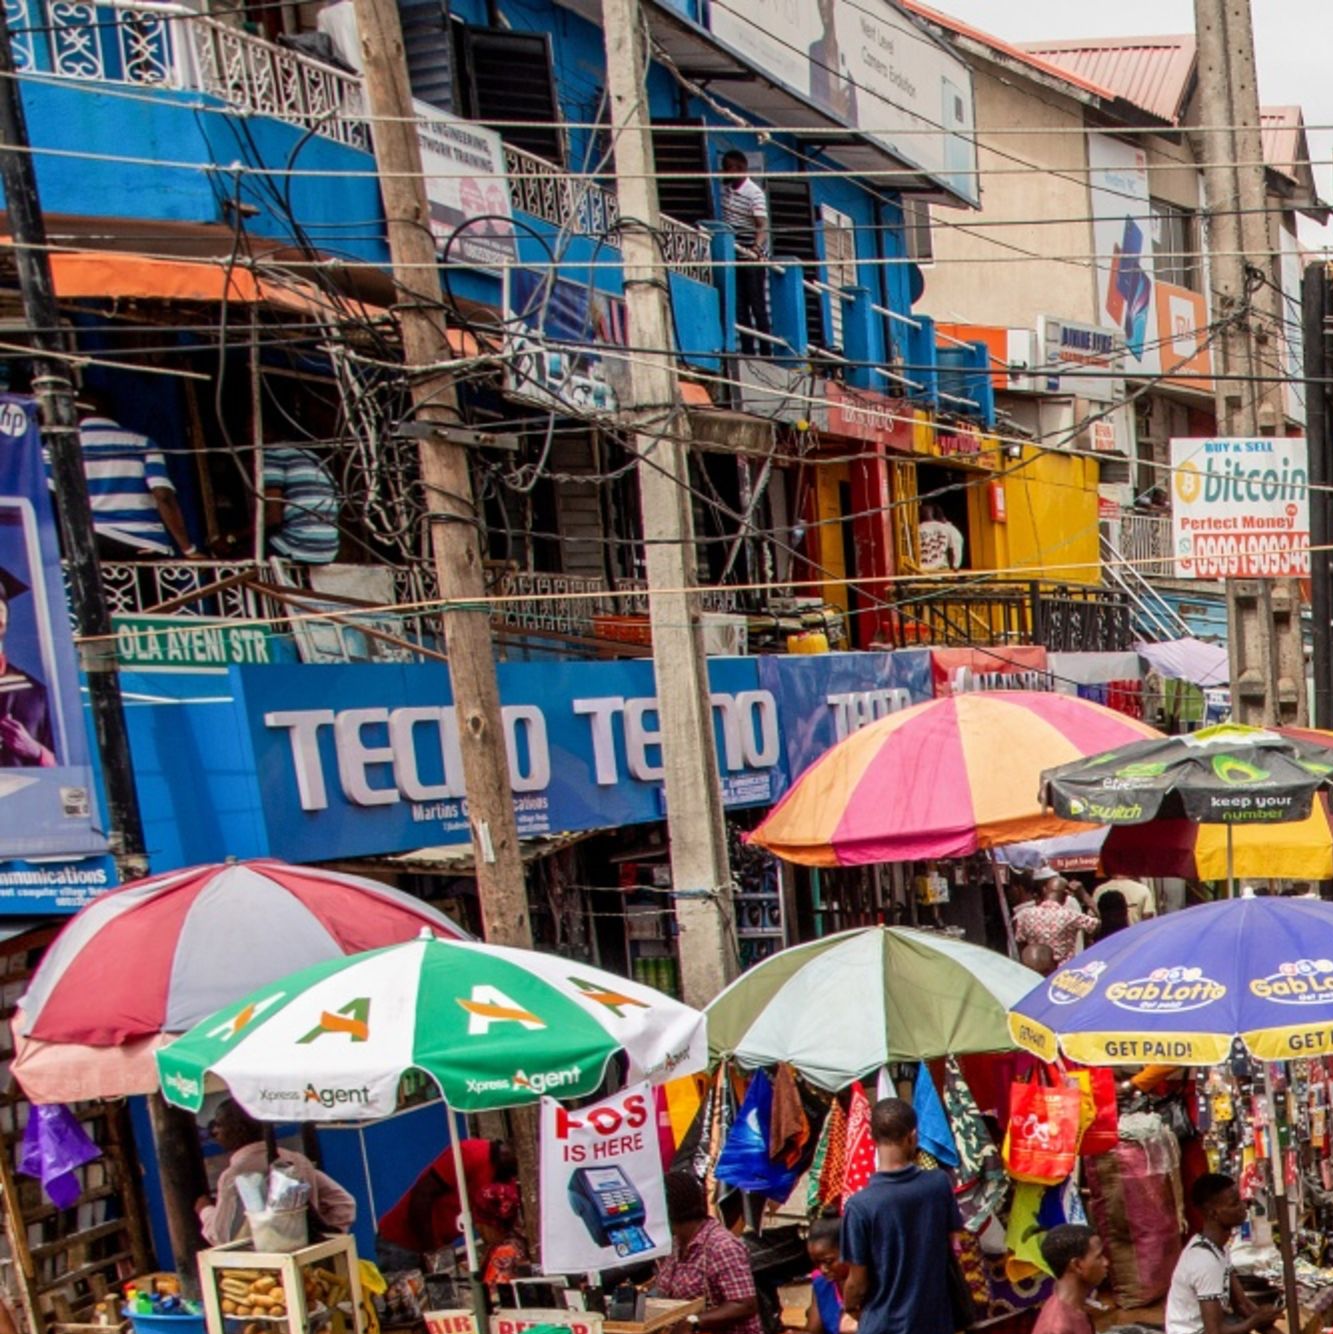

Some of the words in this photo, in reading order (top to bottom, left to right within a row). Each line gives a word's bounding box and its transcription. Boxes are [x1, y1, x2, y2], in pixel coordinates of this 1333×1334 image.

[1205, 442, 1230, 452] BUY
[1246, 441, 1273, 452] SELL
[1204, 457, 1306, 503] bitcoin
[1181, 516, 1237, 531] Perfect
[1243, 514, 1295, 530] Money
[117, 624, 162, 661] OLA
[168, 626, 228, 662] AYENI
[230, 628, 270, 665] STR
[264, 705, 550, 811] TECO
[413, 804, 458, 822] Martins
[1211, 796, 1252, 812] keep
[1257, 795, 1292, 811] your
[1223, 808, 1284, 821] number
[1105, 1041, 1138, 1058] GET
[1142, 1040, 1192, 1058] PAID!
[1288, 1032, 1322, 1052] GET
[466, 1076, 510, 1095] Xpress
[512, 1065, 582, 1095] Agent
[259, 1088, 300, 1102] Xpress
[303, 1083, 370, 1108] Agent
[563, 1143, 588, 1163] IS
[593, 1134, 644, 1160] HERE
